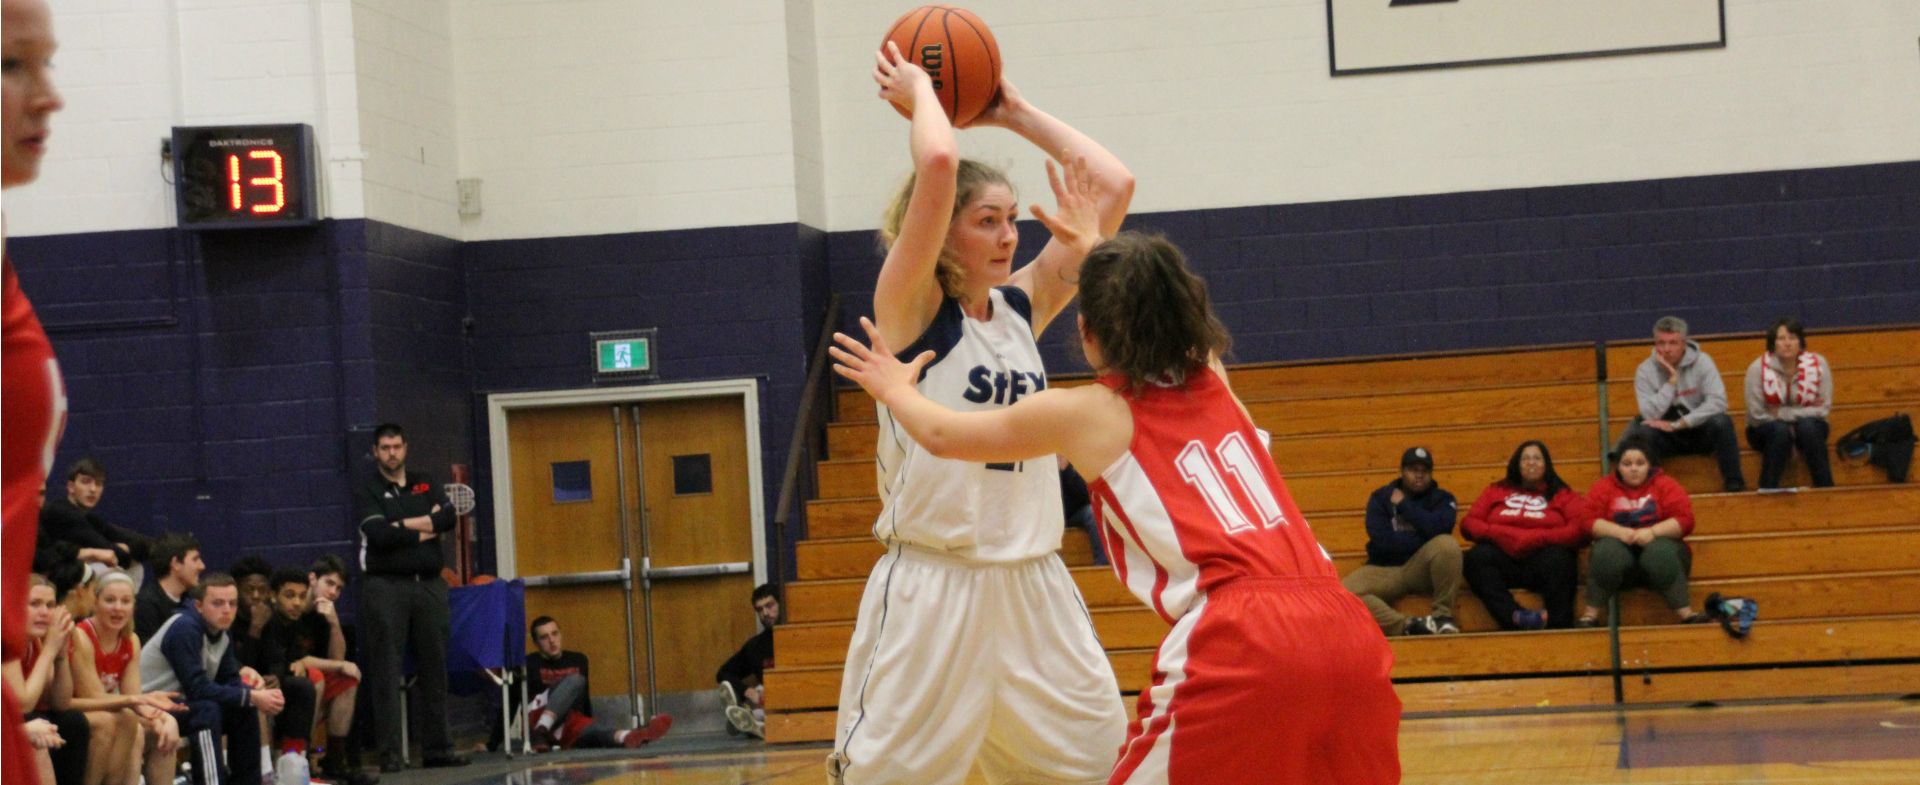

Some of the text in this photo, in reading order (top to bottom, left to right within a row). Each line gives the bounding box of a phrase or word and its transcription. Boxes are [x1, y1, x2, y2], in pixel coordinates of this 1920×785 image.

[209, 138, 274, 147] DAKTRONICS
[229, 150, 284, 213] 13
[1174, 430, 1289, 534] 11
